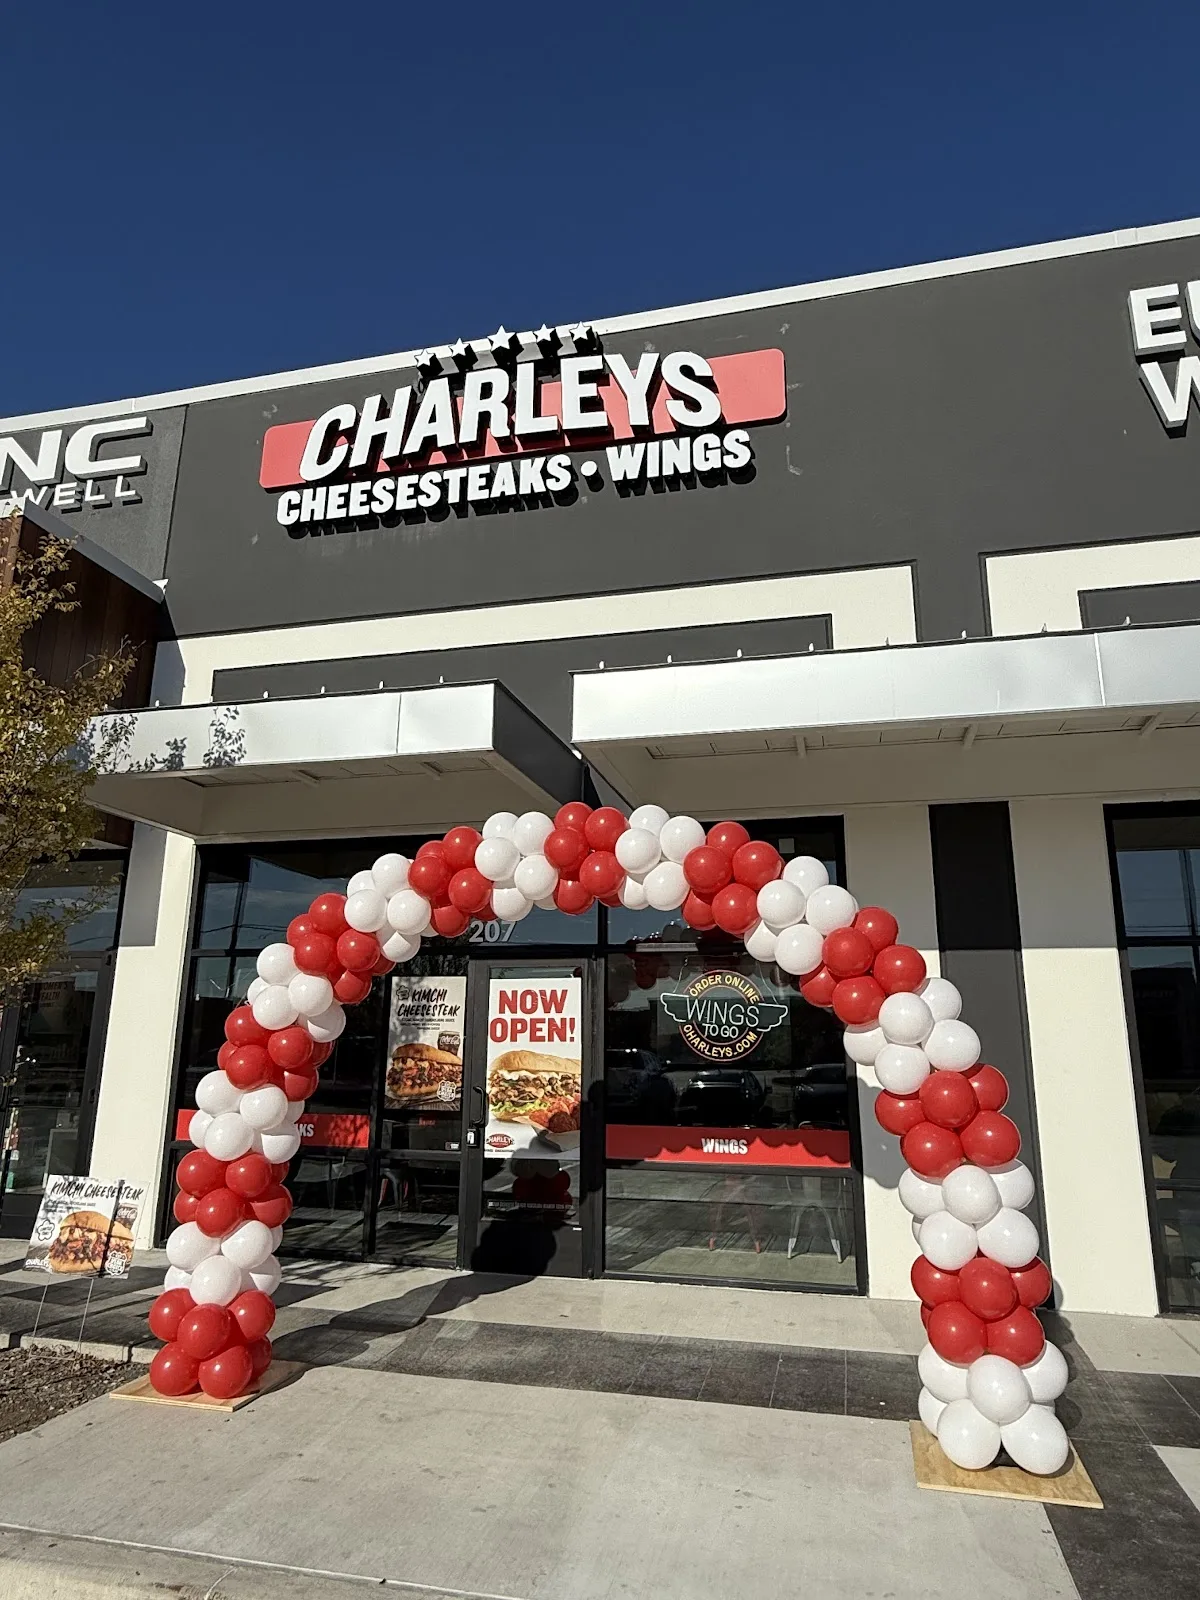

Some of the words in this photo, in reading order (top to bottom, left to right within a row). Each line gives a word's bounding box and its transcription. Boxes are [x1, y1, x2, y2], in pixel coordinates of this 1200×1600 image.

[1129, 280, 1200, 353] E
[298, 351, 723, 482] CHARLEYS
[276, 454, 572, 526] CHEESESTEAKS
[606, 430, 753, 482] WINGS
[469, 920, 518, 943] 207
[41, 991, 61, 1000] EALTH
[43, 982, 68, 990] OMEN'S
[411, 988, 448, 1003] KIMCHI
[689, 974, 722, 997] ORDER
[724, 975, 760, 1004] ONLINE
[397, 1004, 461, 1017] CHEESESTEAK
[498, 989, 569, 1014] NOW
[686, 999, 760, 1027] WINGS
[490, 1017, 576, 1043] OPEN!
[683, 1024, 758, 1057] CHARLEYS.COM
[702, 1023, 719, 1038] TO
[720, 1025, 739, 1038] GO
[701, 1138, 748, 1155] WINGS
[50, 1181, 84, 1198] KIMCHI
[84, 1182, 144, 1200] CHEESESTEAK
